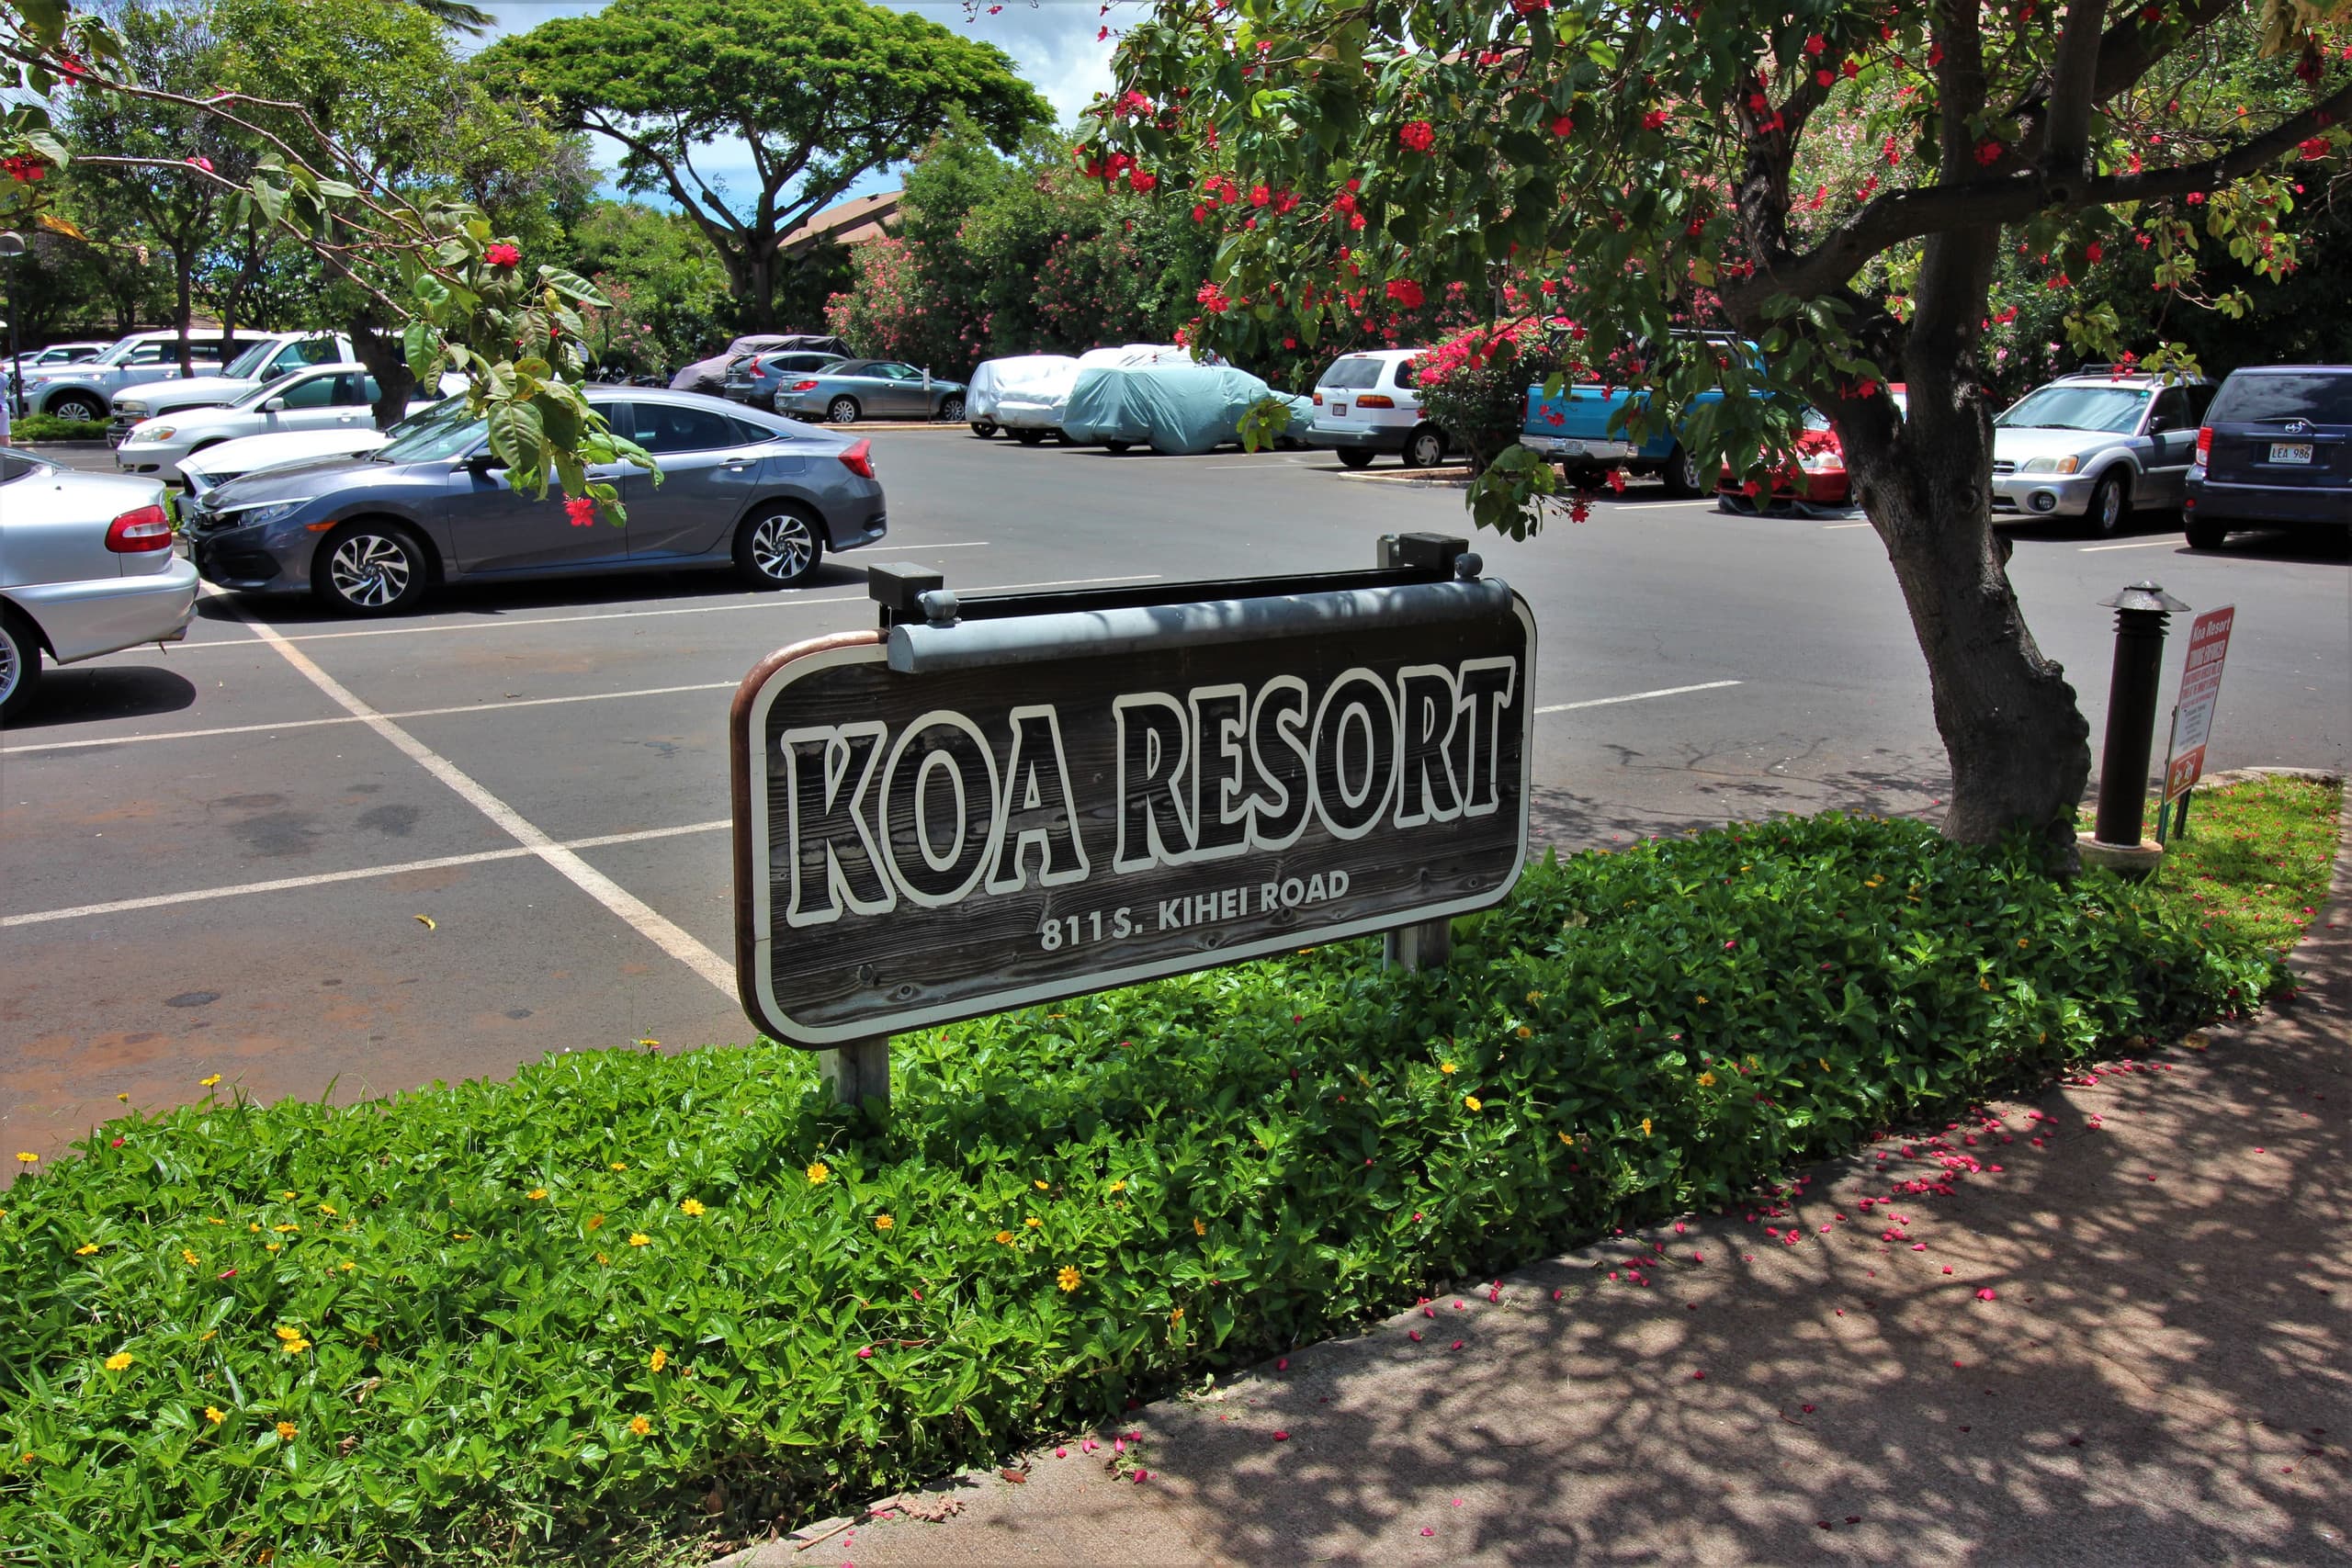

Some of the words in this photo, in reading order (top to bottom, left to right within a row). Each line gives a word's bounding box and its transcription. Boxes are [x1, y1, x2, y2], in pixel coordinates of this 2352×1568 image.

[2272, 448, 2288, 458] LEA
[2192, 626, 2205, 642] Koa
[2206, 617, 2231, 637] Resort
[781, 704, 1091, 928] KOA
[1113, 656, 1516, 874] RESORT
[1041, 910, 1102, 952] 811
[1113, 907, 1144, 939] S.
[1159, 886, 1248, 931] KIHEI
[1261, 870, 1350, 911] ROAD
